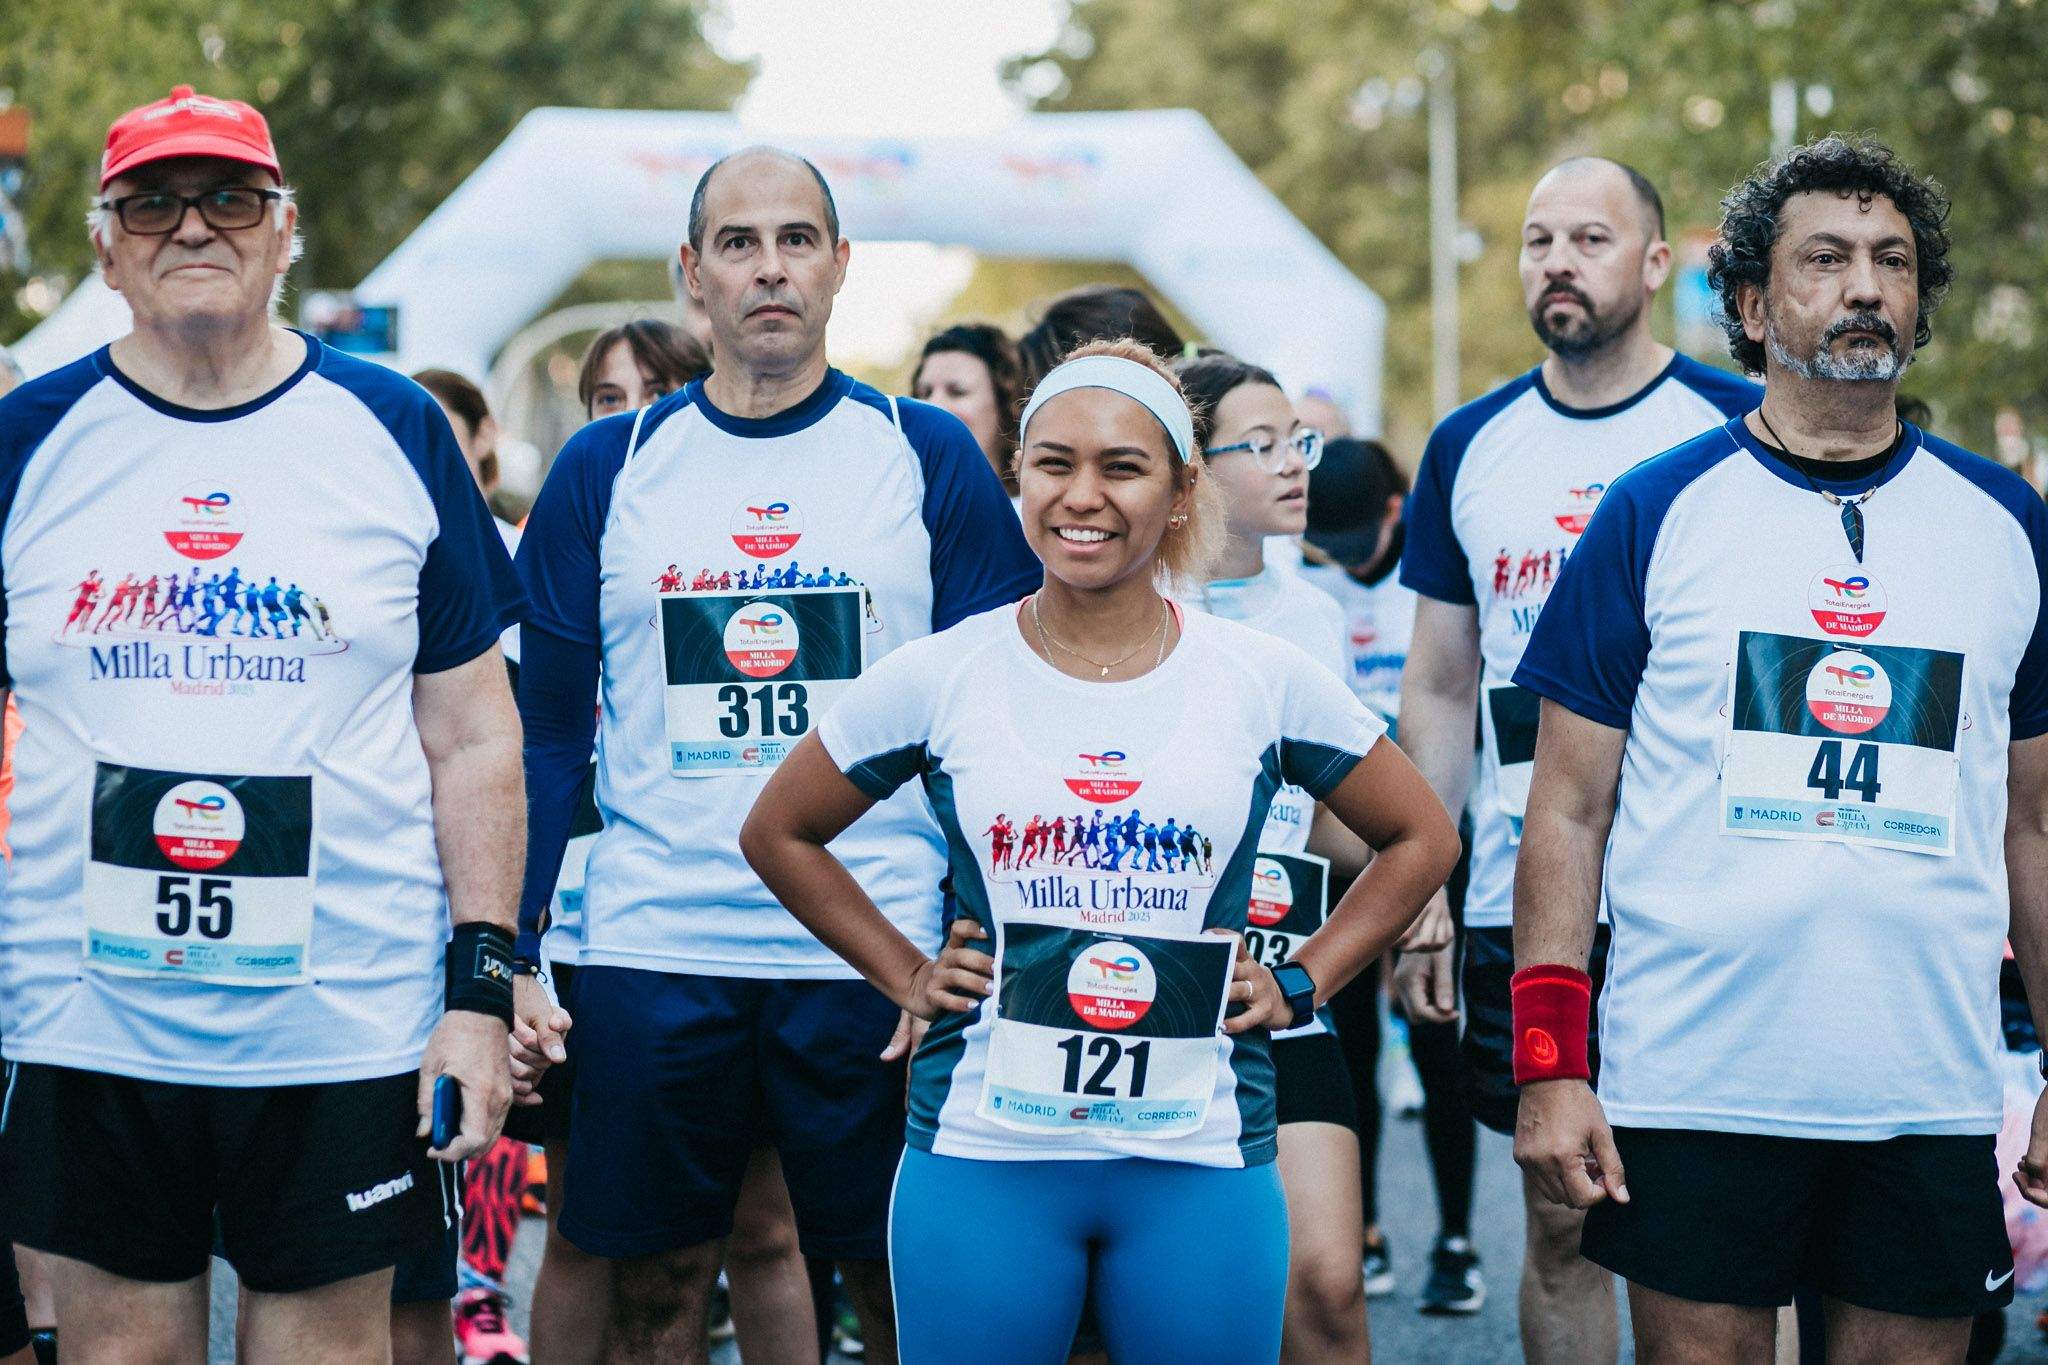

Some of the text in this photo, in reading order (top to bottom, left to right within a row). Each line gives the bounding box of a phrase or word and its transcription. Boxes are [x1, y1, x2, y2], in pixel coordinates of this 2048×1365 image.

[1825, 599, 1871, 610] TotalEnergies
[1836, 614, 1862, 624] MILLA
[1825, 621, 1873, 632] DE MADRID
[750, 651, 776, 659] MILLA
[89, 642, 305, 682] Milla Urbana
[740, 659, 786, 668] DE MADRID
[170, 682, 225, 696] Madrid
[1824, 688, 1874, 700] TotalEnergies
[717, 683, 809, 738] 313
[1834, 704, 1864, 715] MILLA
[1823, 711, 1874, 725] DE MADRID
[687, 750, 731, 761] MADRID
[1807, 740, 1882, 803] 44
[1750, 808, 1802, 822] MADRID
[1016, 875, 1188, 911] Milla Urbana
[156, 876, 233, 940] 55
[1080, 910, 1126, 923] Madrid
[1096, 998, 1126, 1009] MILLA
[1083, 1006, 1136, 1019] DE MADRID
[1057, 1034, 1151, 1097] 121
[1008, 1100, 1057, 1117] MADRID
